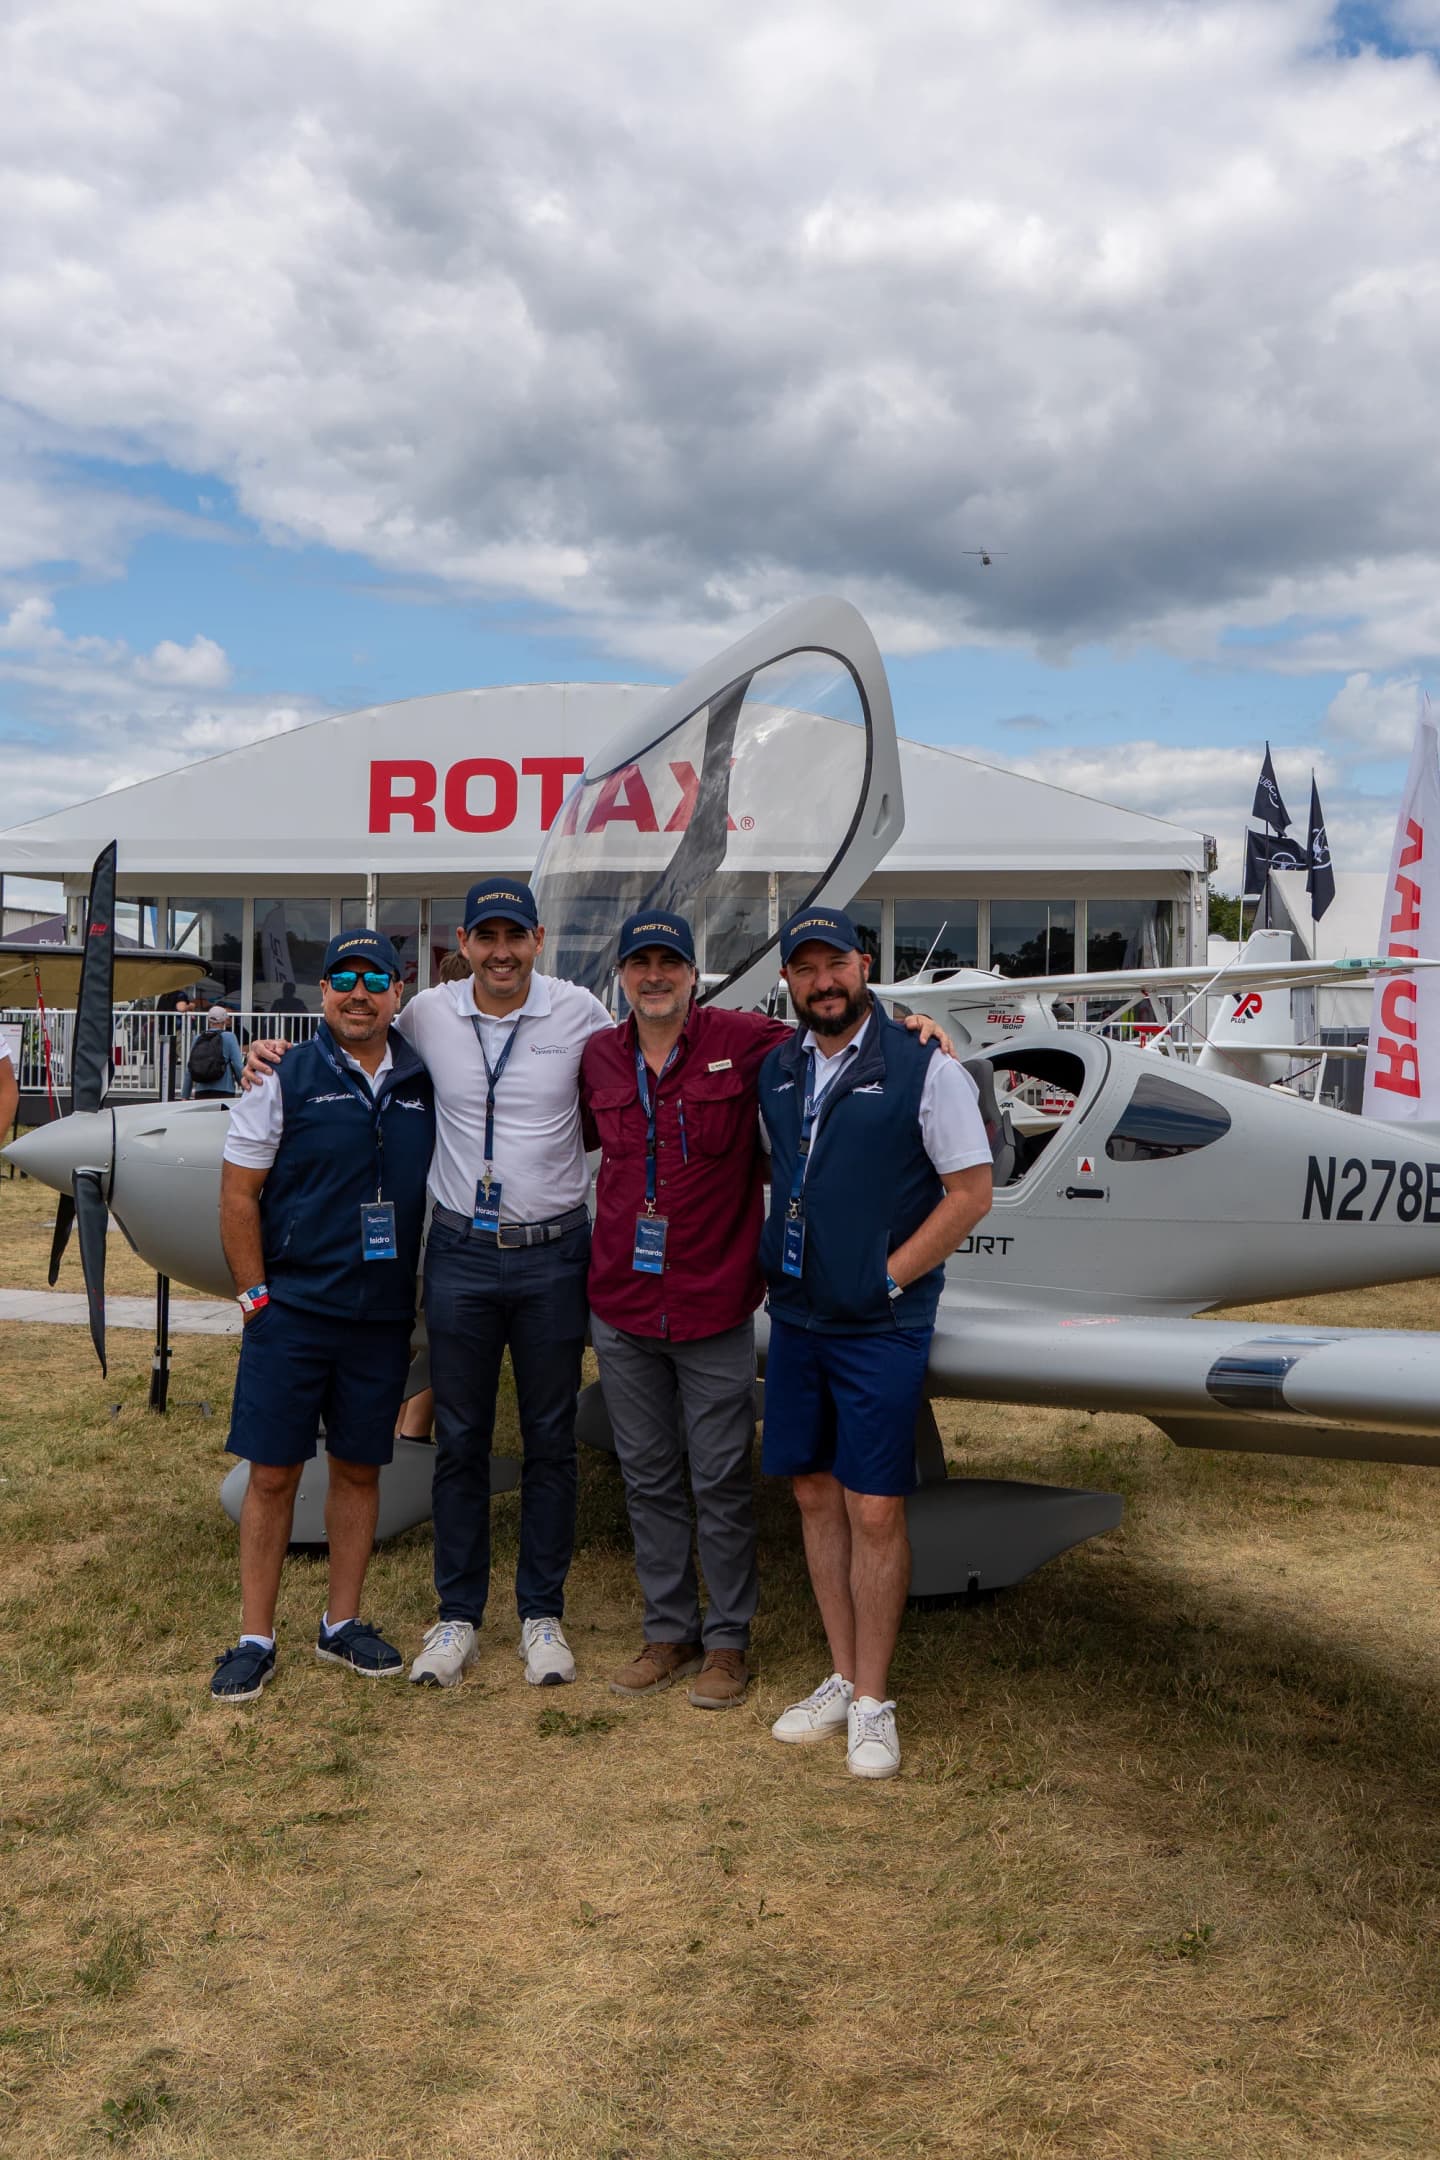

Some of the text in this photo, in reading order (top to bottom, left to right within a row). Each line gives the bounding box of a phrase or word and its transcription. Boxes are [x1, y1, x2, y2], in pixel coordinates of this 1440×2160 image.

[477, 892, 523, 904] BRISTELL
[632, 923, 680, 937] BRISTELL
[790, 919, 838, 936] BRISTELL
[475, 1205, 500, 1217] Horacio
[369, 1236, 391, 1245] Isidro
[635, 1246, 663, 1257] Bernardo
